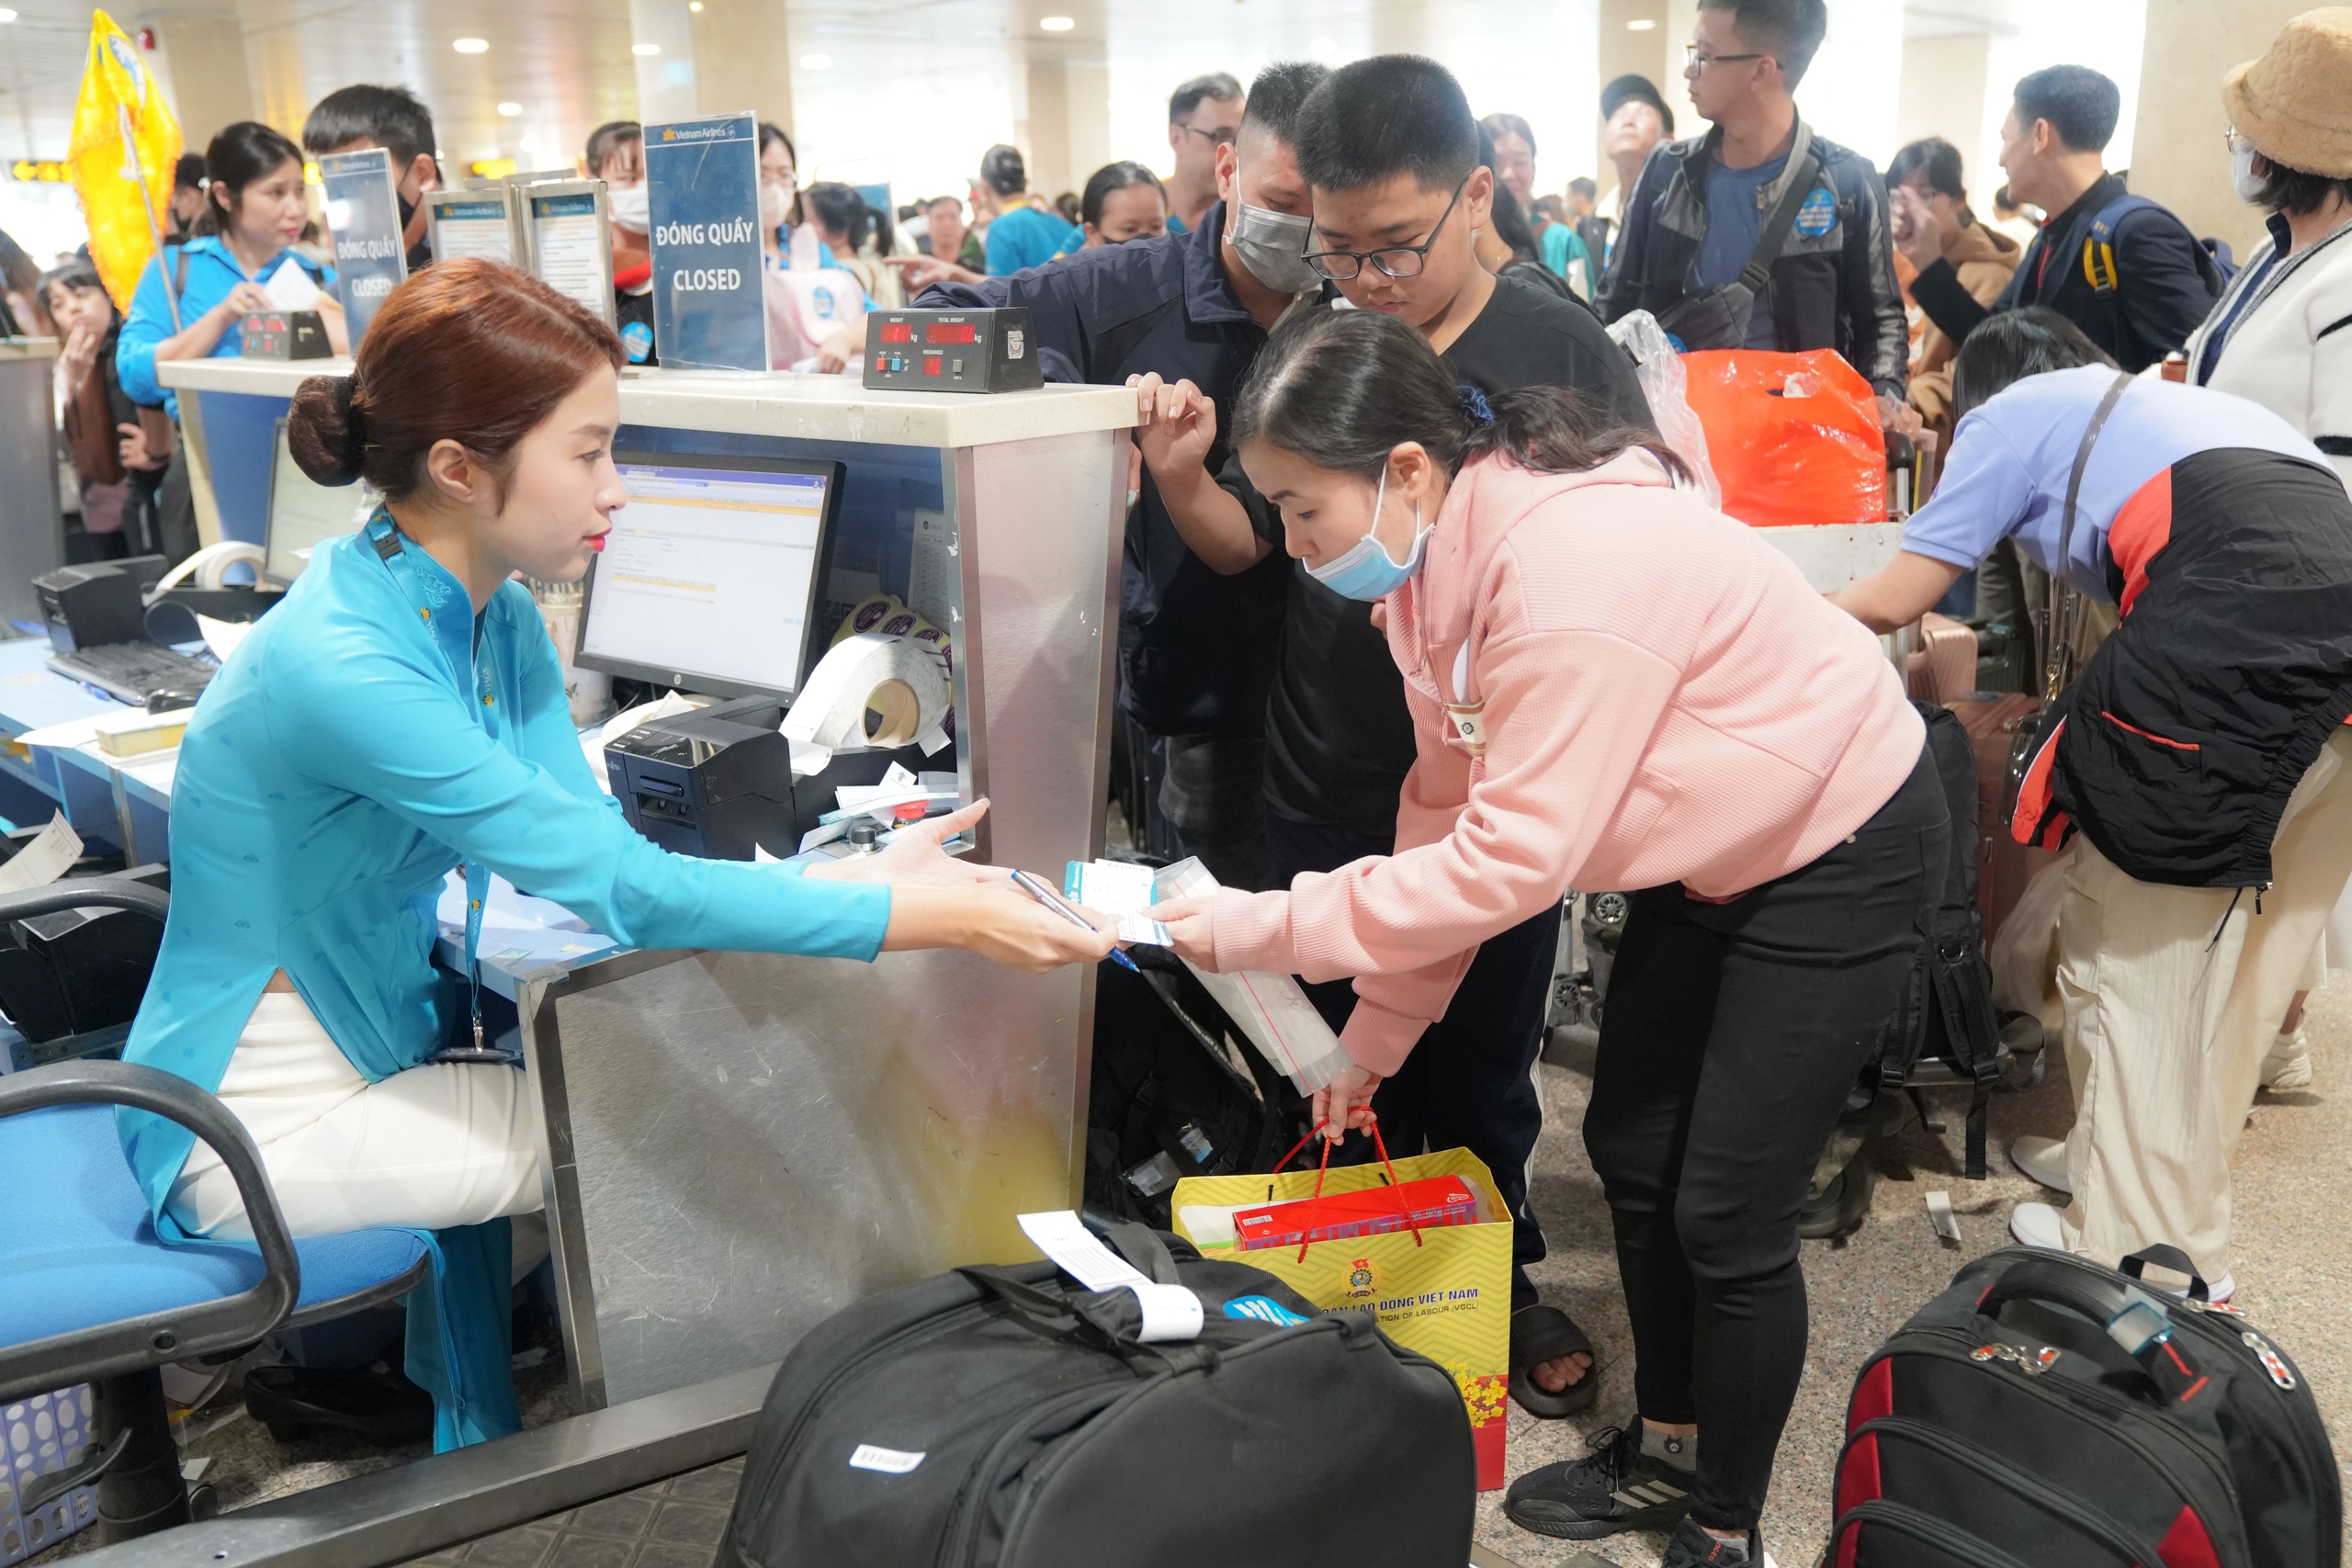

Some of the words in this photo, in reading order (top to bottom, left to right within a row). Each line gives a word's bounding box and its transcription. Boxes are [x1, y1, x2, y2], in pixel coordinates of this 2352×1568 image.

[655, 220, 705, 246] ĐÓNG
[708, 216, 753, 246] QUẦY
[351, 278, 393, 298] CLOSED
[673, 268, 741, 291] CLOSED
[910, 333, 918, 342] kg
[974, 334, 982, 343] kg
[483, 667, 493, 694] VIAGS
[1380, 1296, 1414, 1312] ĐỘNG
[1419, 1291, 1445, 1305] VIỆT
[1448, 1288, 1478, 1300] NAM
[1416, 1305, 1450, 1316] LABOUR
[1452, 1303, 1479, 1313] (VGCL)
